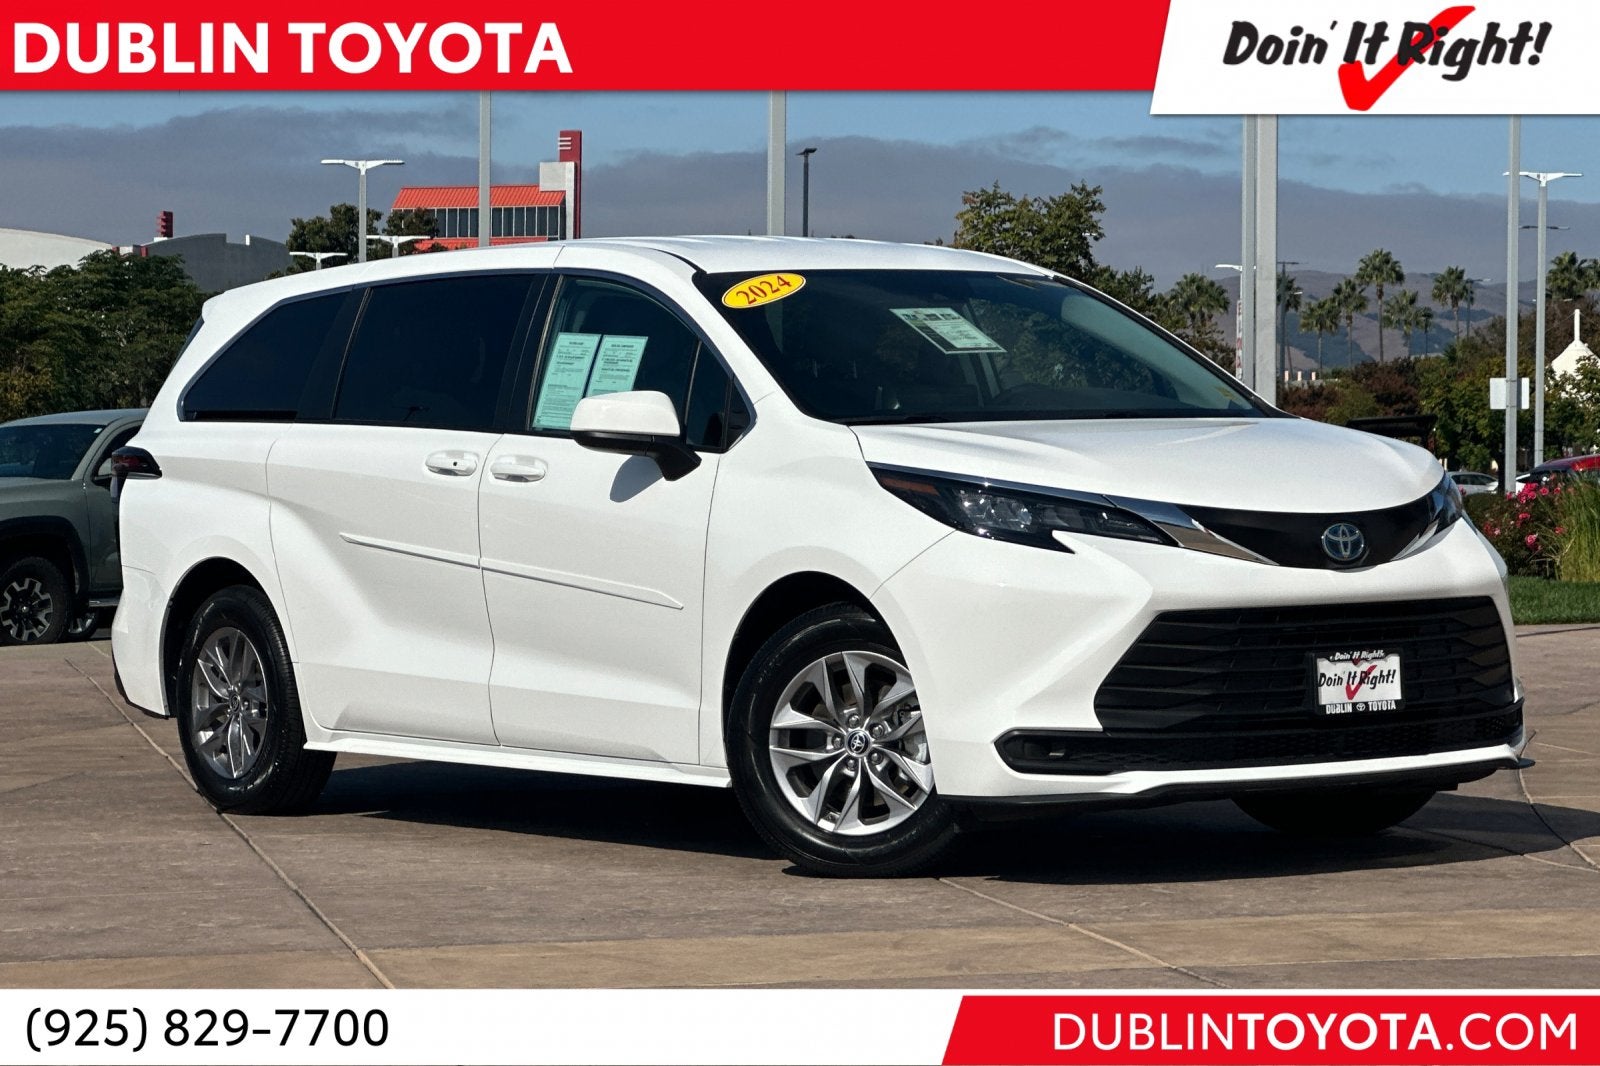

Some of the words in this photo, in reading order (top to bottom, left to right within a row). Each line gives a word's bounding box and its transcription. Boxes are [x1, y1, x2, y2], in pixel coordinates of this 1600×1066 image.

[736, 275, 791, 304] 2024
[1346, 671, 1357, 685] It
[1360, 669, 1397, 690] Right!
[1326, 702, 1353, 714] DUBLIN
[1368, 700, 1396, 712] TOYOTA
